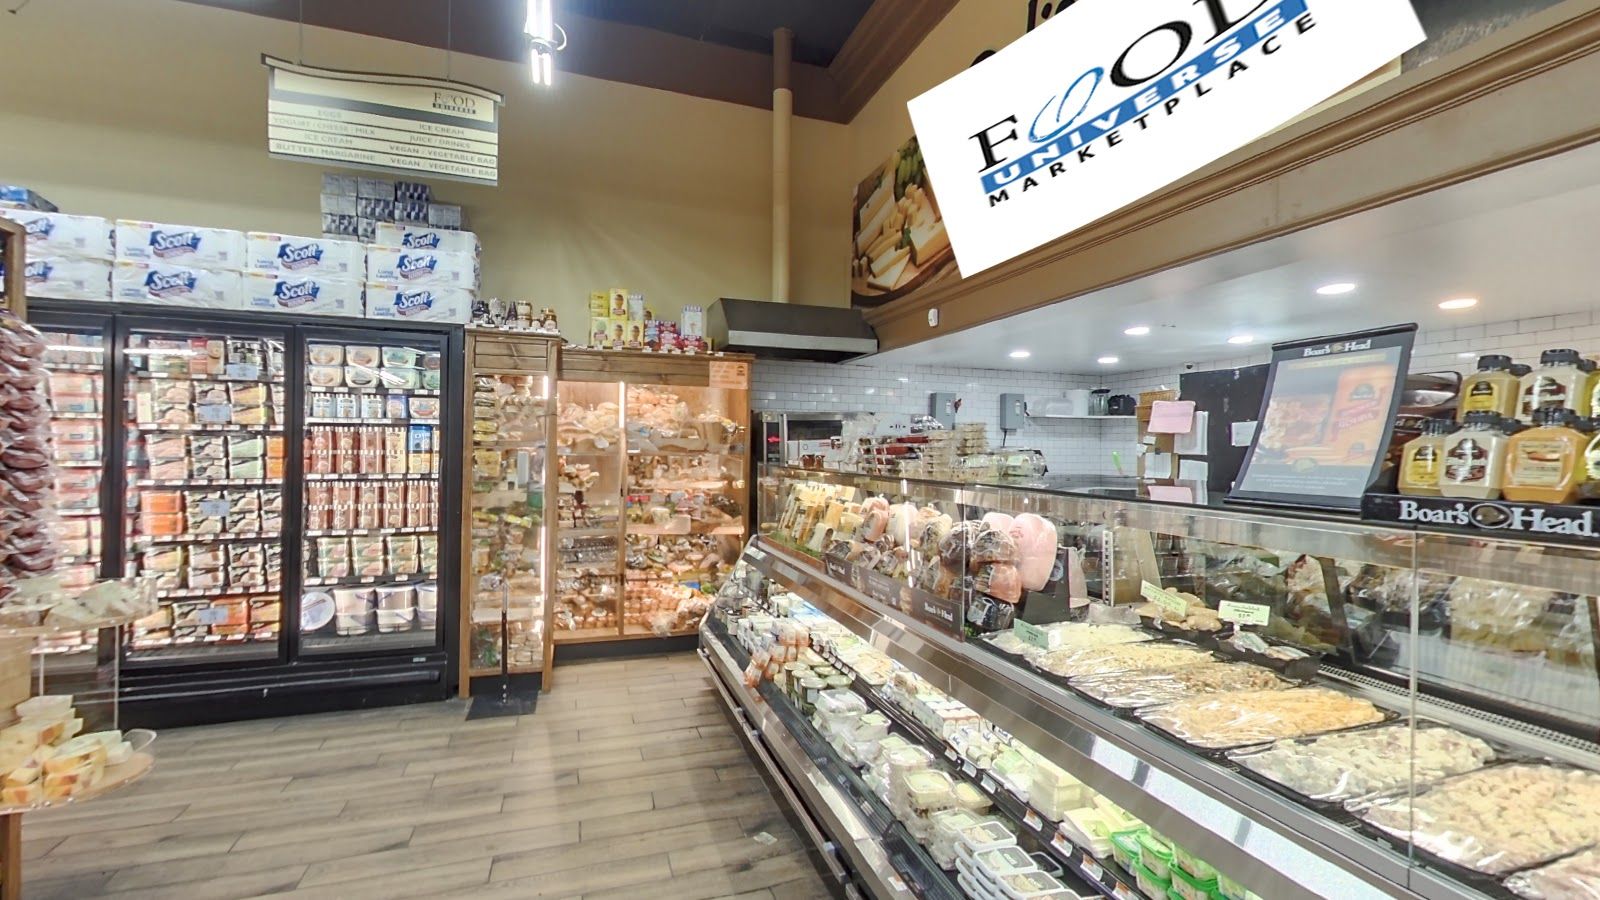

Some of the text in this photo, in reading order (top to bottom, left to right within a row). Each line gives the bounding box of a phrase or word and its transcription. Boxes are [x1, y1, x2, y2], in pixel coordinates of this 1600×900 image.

[355, 127, 375, 135] MILK
[419, 123, 465, 136] ICE CREAM
[321, 135, 353, 145] CREAM
[410, 135, 433, 144] JUICE
[438, 139, 471, 149] DRINKS
[274, 142, 314, 154] BUTTER
[320, 149, 376, 161] MARGARINE
[389, 145, 420, 154] VEGAN
[427, 149, 475, 163] VEGETABLE
[390, 157, 421, 167] VEGAN
[428, 162, 476, 175] VEGETABLE
[154, 231, 196, 250] Scott
[406, 232, 436, 249] Scott
[283, 243, 319, 262] Scott
[402, 255, 434, 271] Scott
[149, 271, 193, 290] Scott
[279, 281, 317, 300] Scott
[399, 291, 434, 309] Scott
[1344, 339, 1372, 352] Head
[1399, 500, 1470, 525] Boar's
